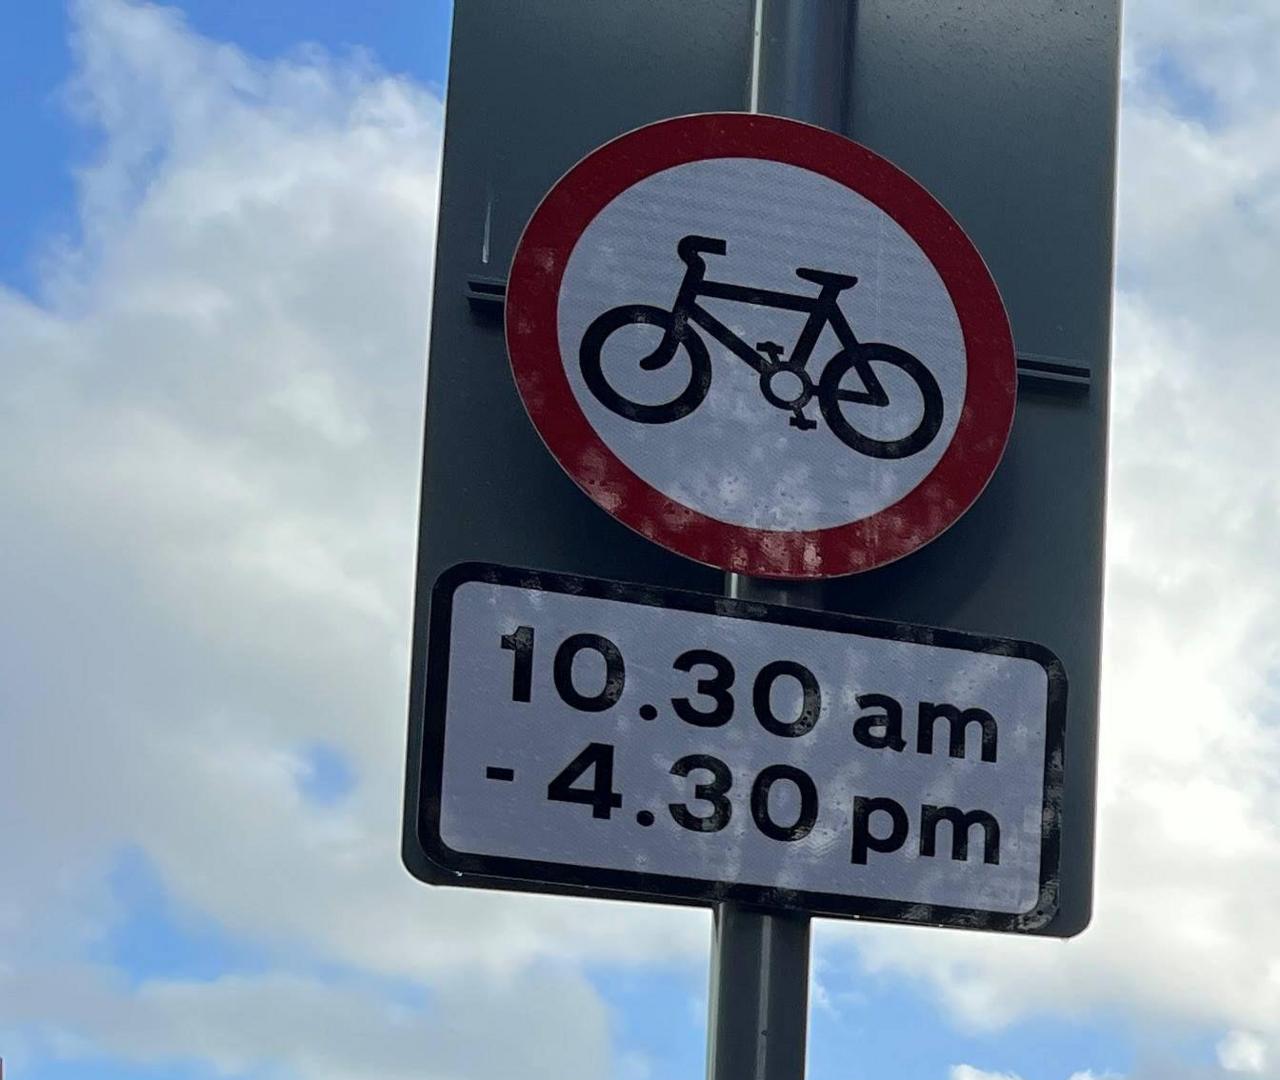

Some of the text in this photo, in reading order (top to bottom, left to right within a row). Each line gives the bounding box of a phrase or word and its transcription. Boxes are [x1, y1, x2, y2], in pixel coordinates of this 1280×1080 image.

[499, 626, 1000, 763] 10.30 am
[547, 741, 819, 842] 4.30
[849, 794, 1001, 866] pm
